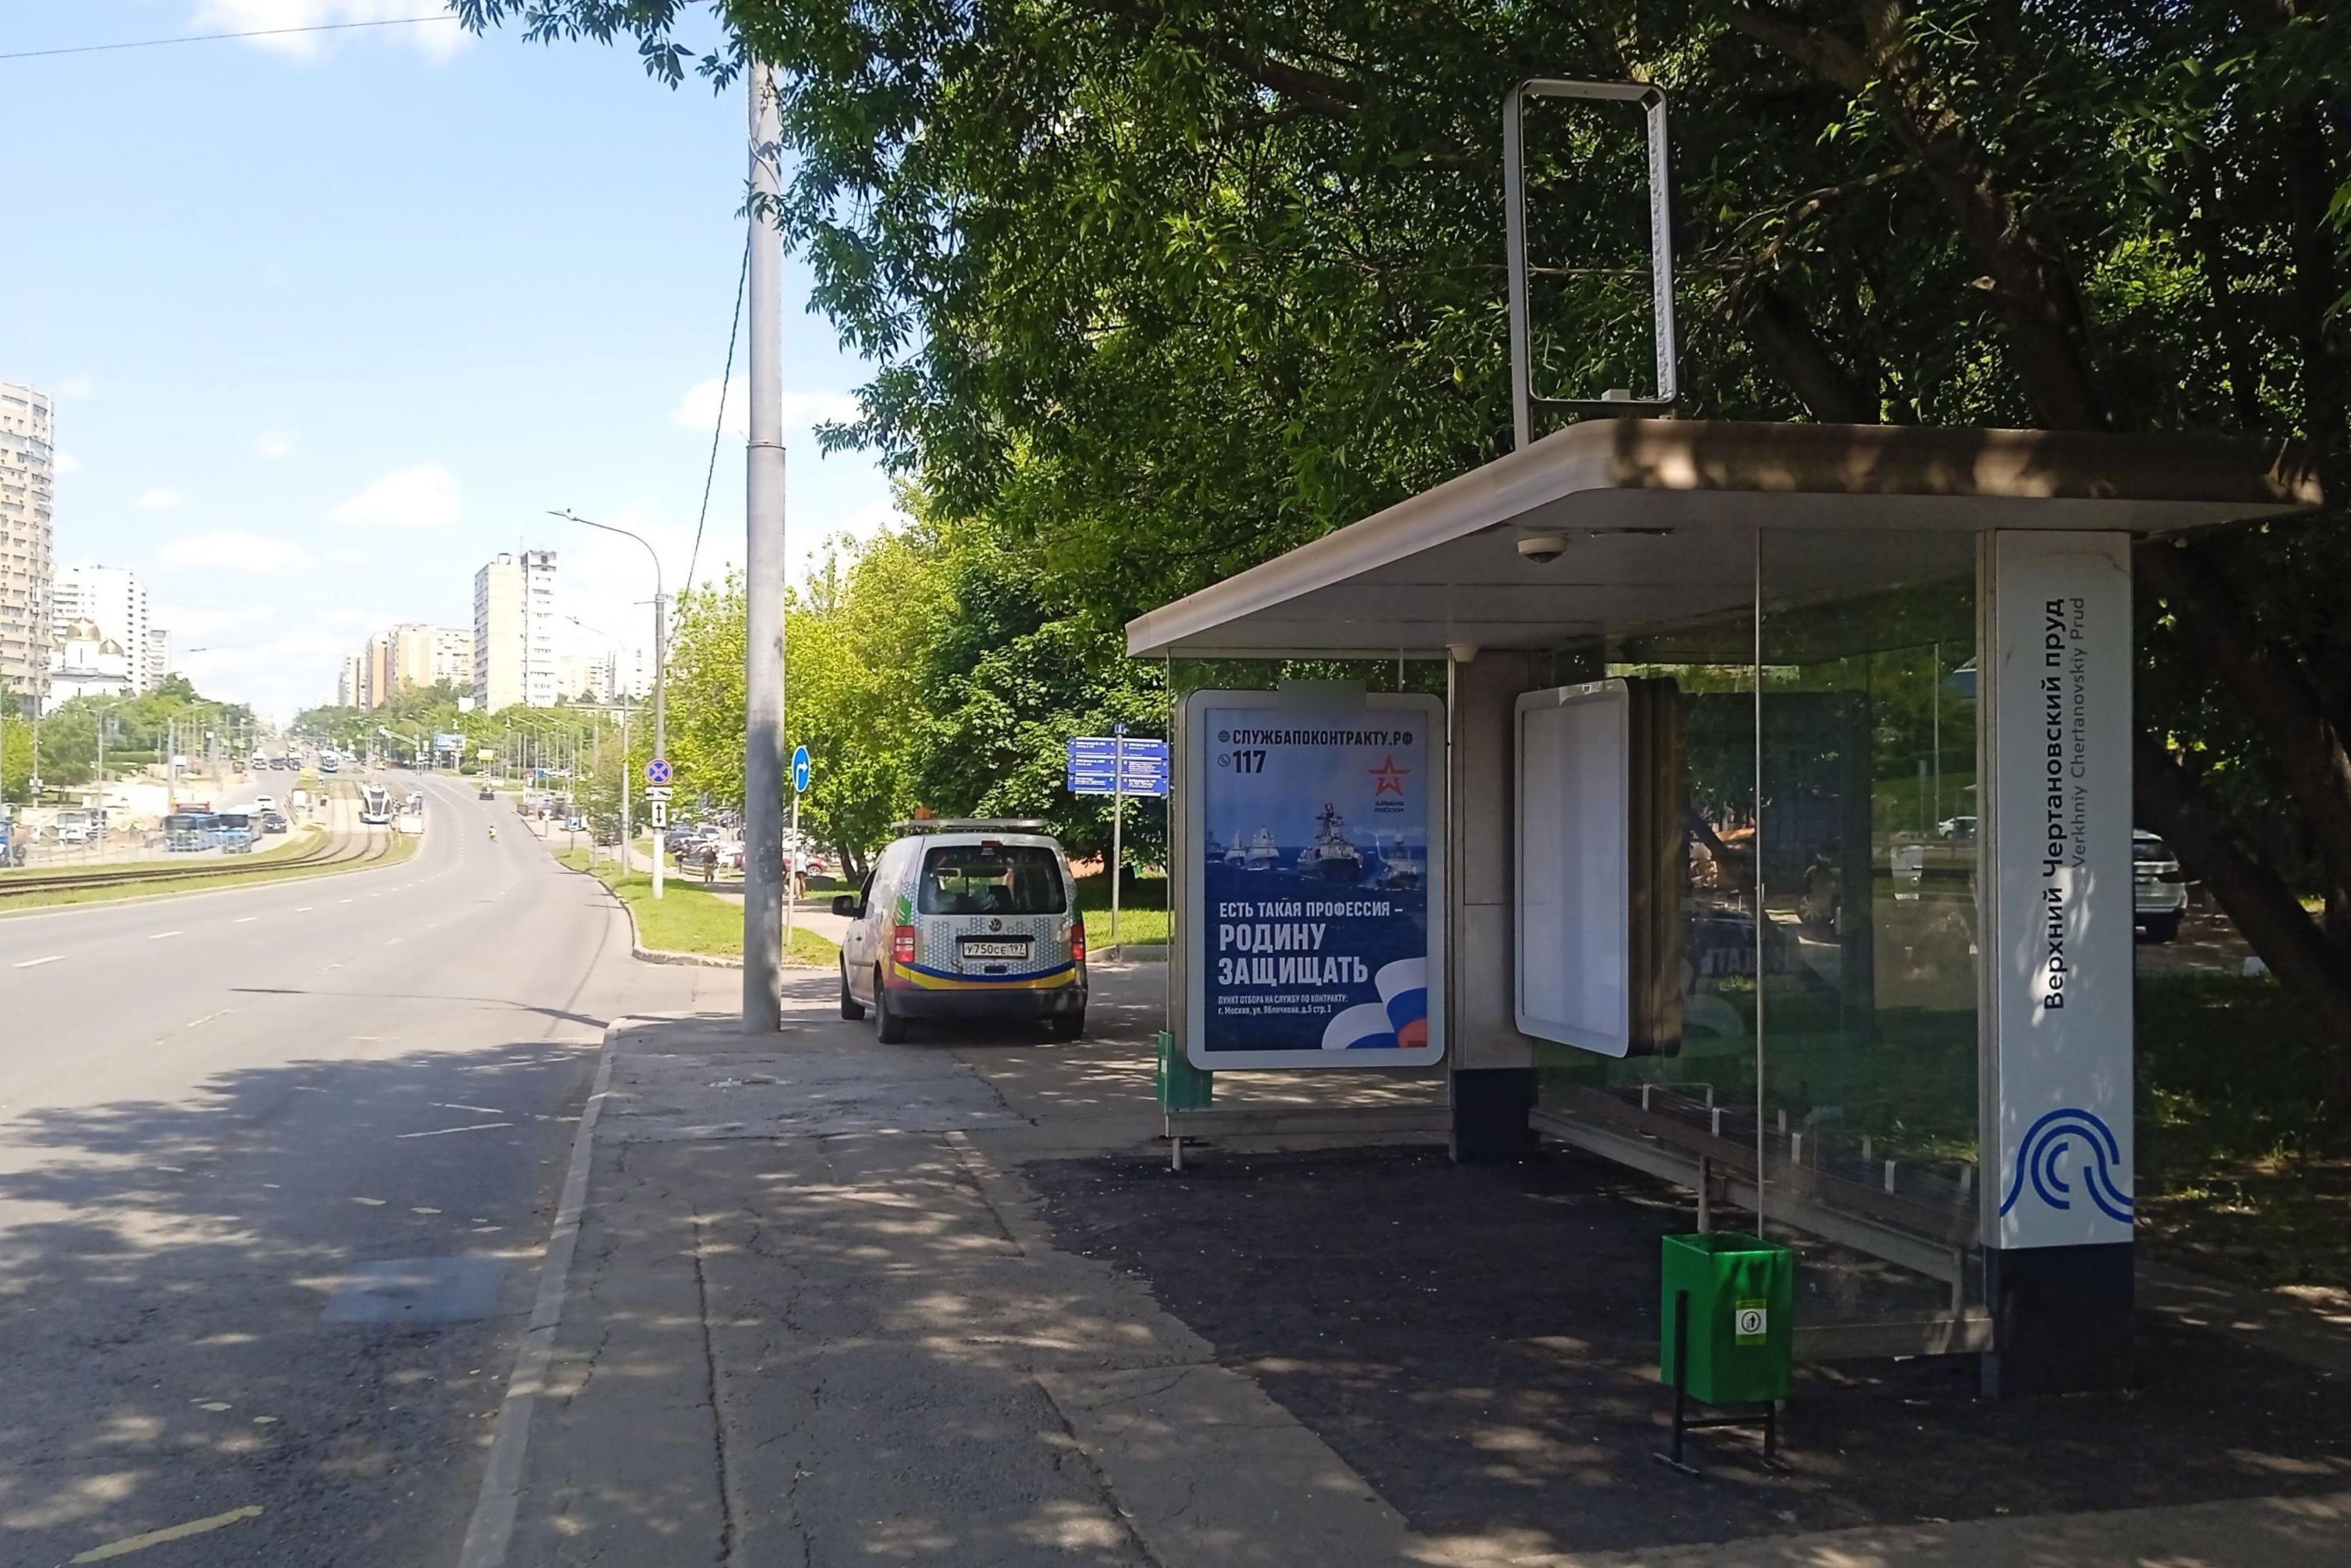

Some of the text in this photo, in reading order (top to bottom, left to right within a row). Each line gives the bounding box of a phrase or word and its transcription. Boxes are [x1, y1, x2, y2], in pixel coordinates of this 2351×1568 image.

[1233, 730, 1413, 746] СЛУЖБАПОКОНТРАКТУ.РФ
[2069, 597, 2088, 868] Verkhniy Chertanovskiy Prud
[1232, 750, 1267, 773] 117
[2040, 598, 2068, 1011] Верхний Чертановский пруд
[1220, 902, 1253, 918] ЕСТЬ
[1257, 902, 1301, 917] ТАКАЯ
[1306, 901, 1390, 917] ПРОФЕССИЯ
[1009, 944, 1024, 952] 197
[1219, 923, 1327, 953] РОДИНУ
[1218, 956, 1368, 986] ЗАЩИЩАТЬ
[1218, 994, 1348, 1004] ПУНКТ ОТБОРА НА СЛУЖБУ ПО КОНТРАКТУ:
[1225, 1006, 1253, 1016] Москва,
[1327, 1004, 1331, 1013] 1
